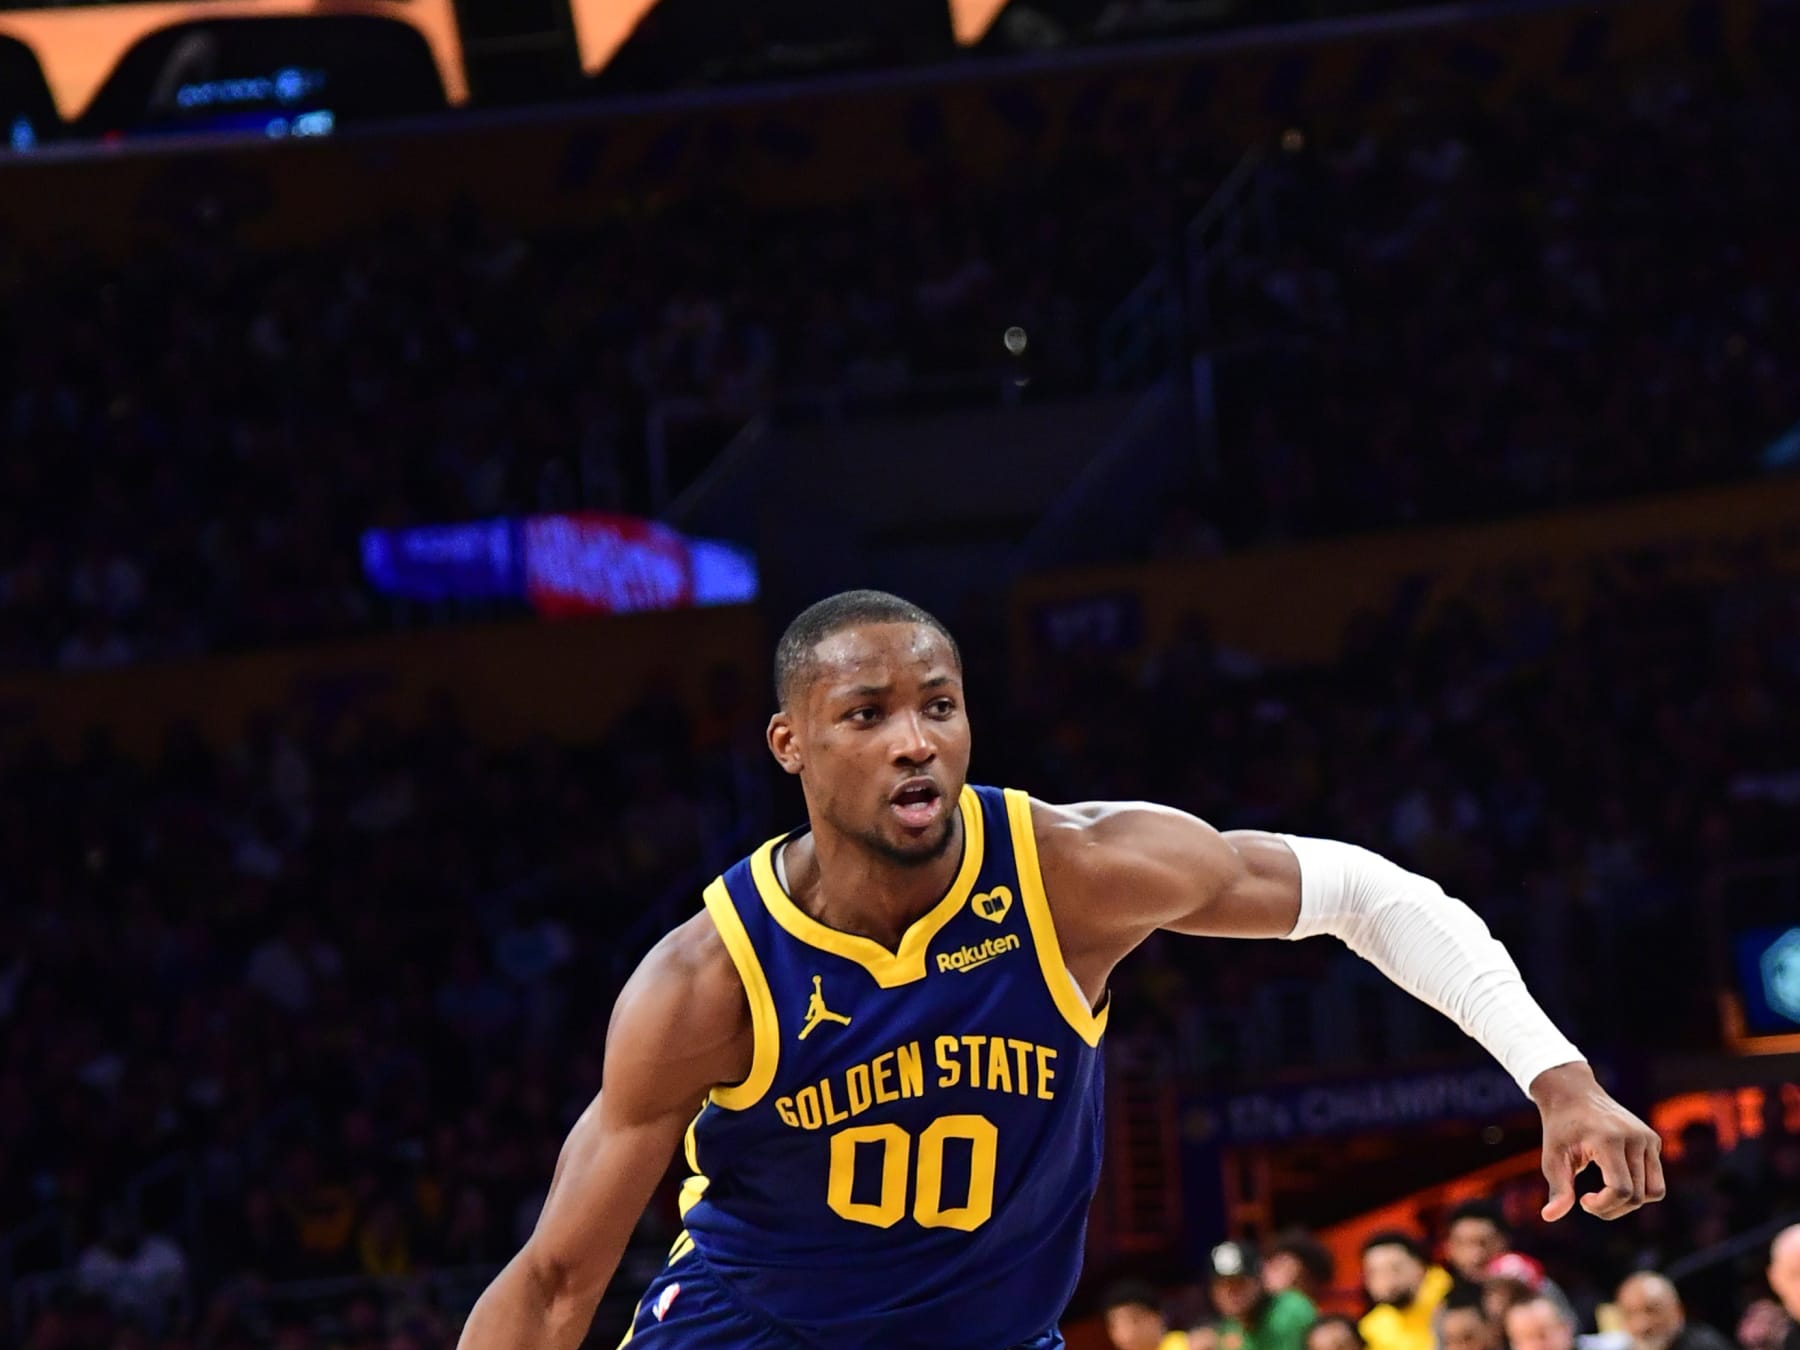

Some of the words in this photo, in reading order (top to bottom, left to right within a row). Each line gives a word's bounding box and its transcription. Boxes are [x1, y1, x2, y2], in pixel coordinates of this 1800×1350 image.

[982, 895, 1006, 915] DM
[936, 933, 1020, 973] Rakuten
[775, 1041, 924, 1130] GOLDEN
[935, 1035, 1057, 1100] STATE
[827, 1114, 998, 1232] 00
